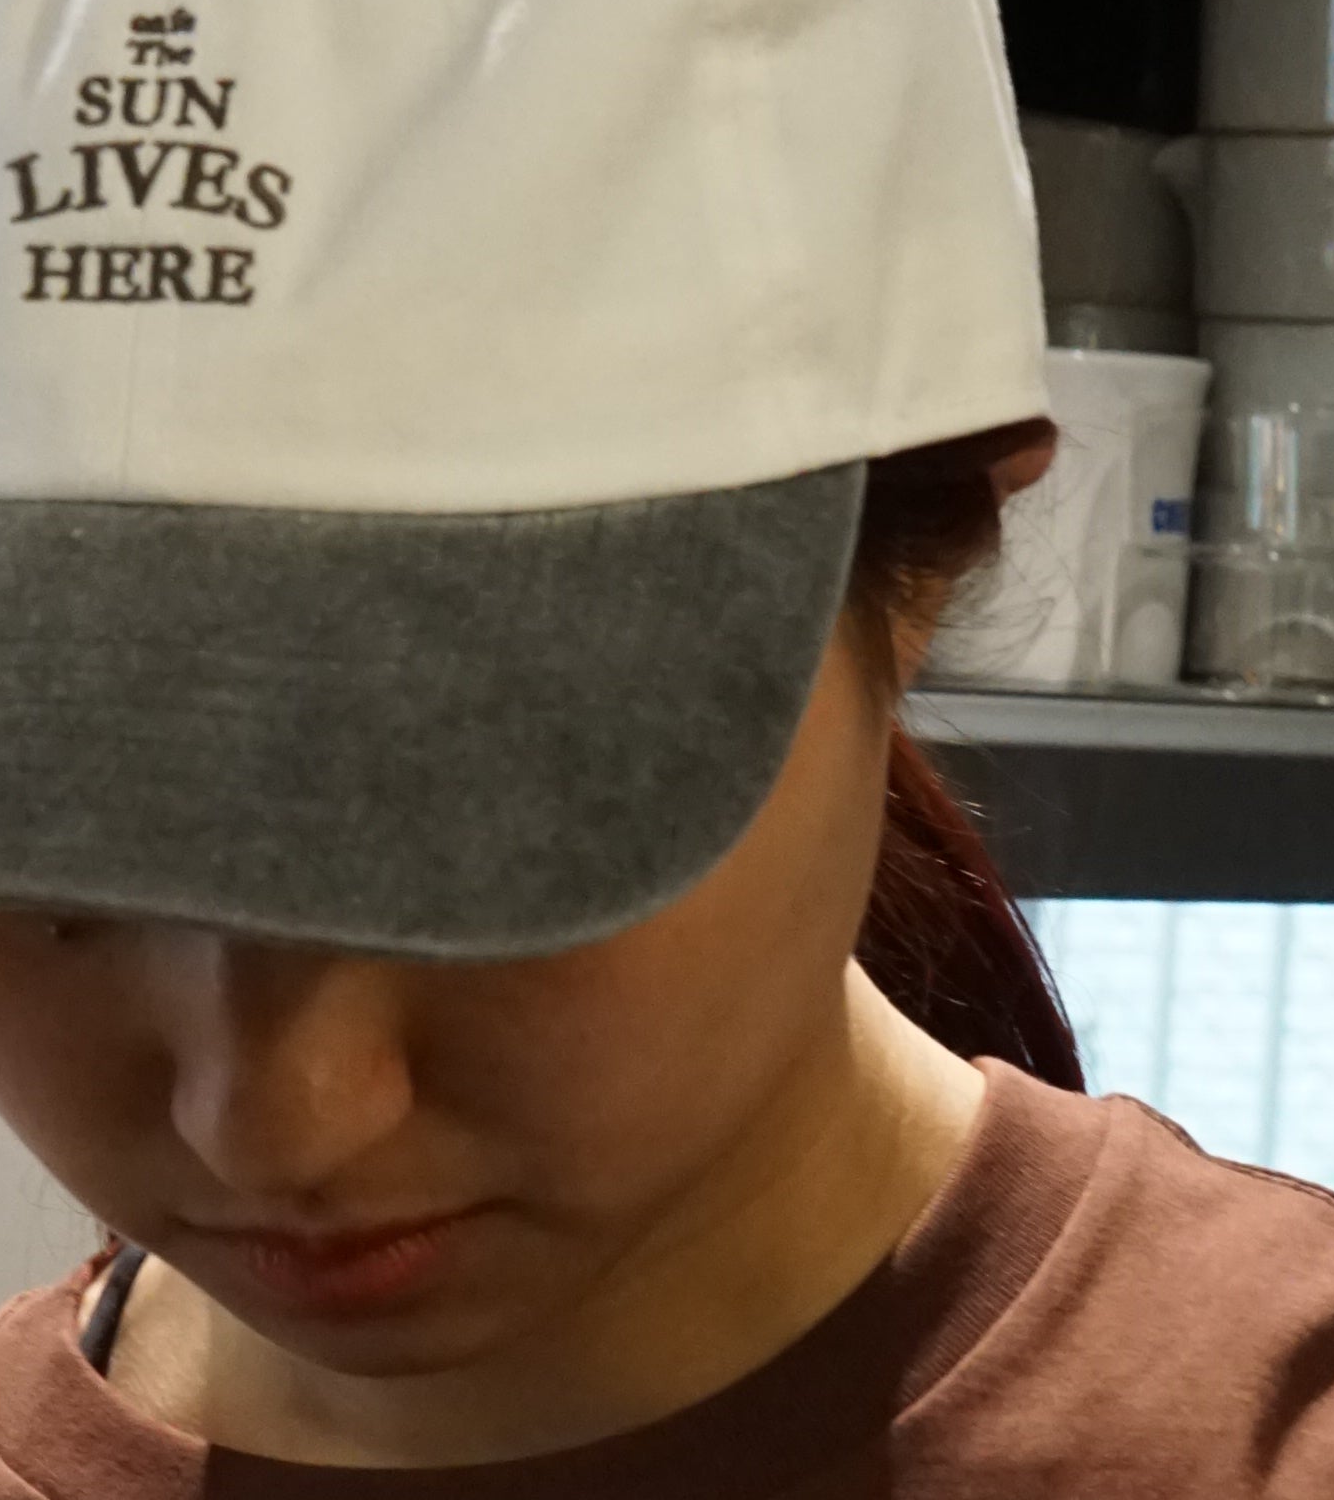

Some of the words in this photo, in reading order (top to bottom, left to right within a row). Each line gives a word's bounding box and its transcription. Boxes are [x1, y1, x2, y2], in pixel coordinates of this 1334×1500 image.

[124, 39, 196, 67] The
[74, 75, 237, 130] SUN
[4, 140, 293, 232] LIVES
[21, 243, 257, 307] HERE
